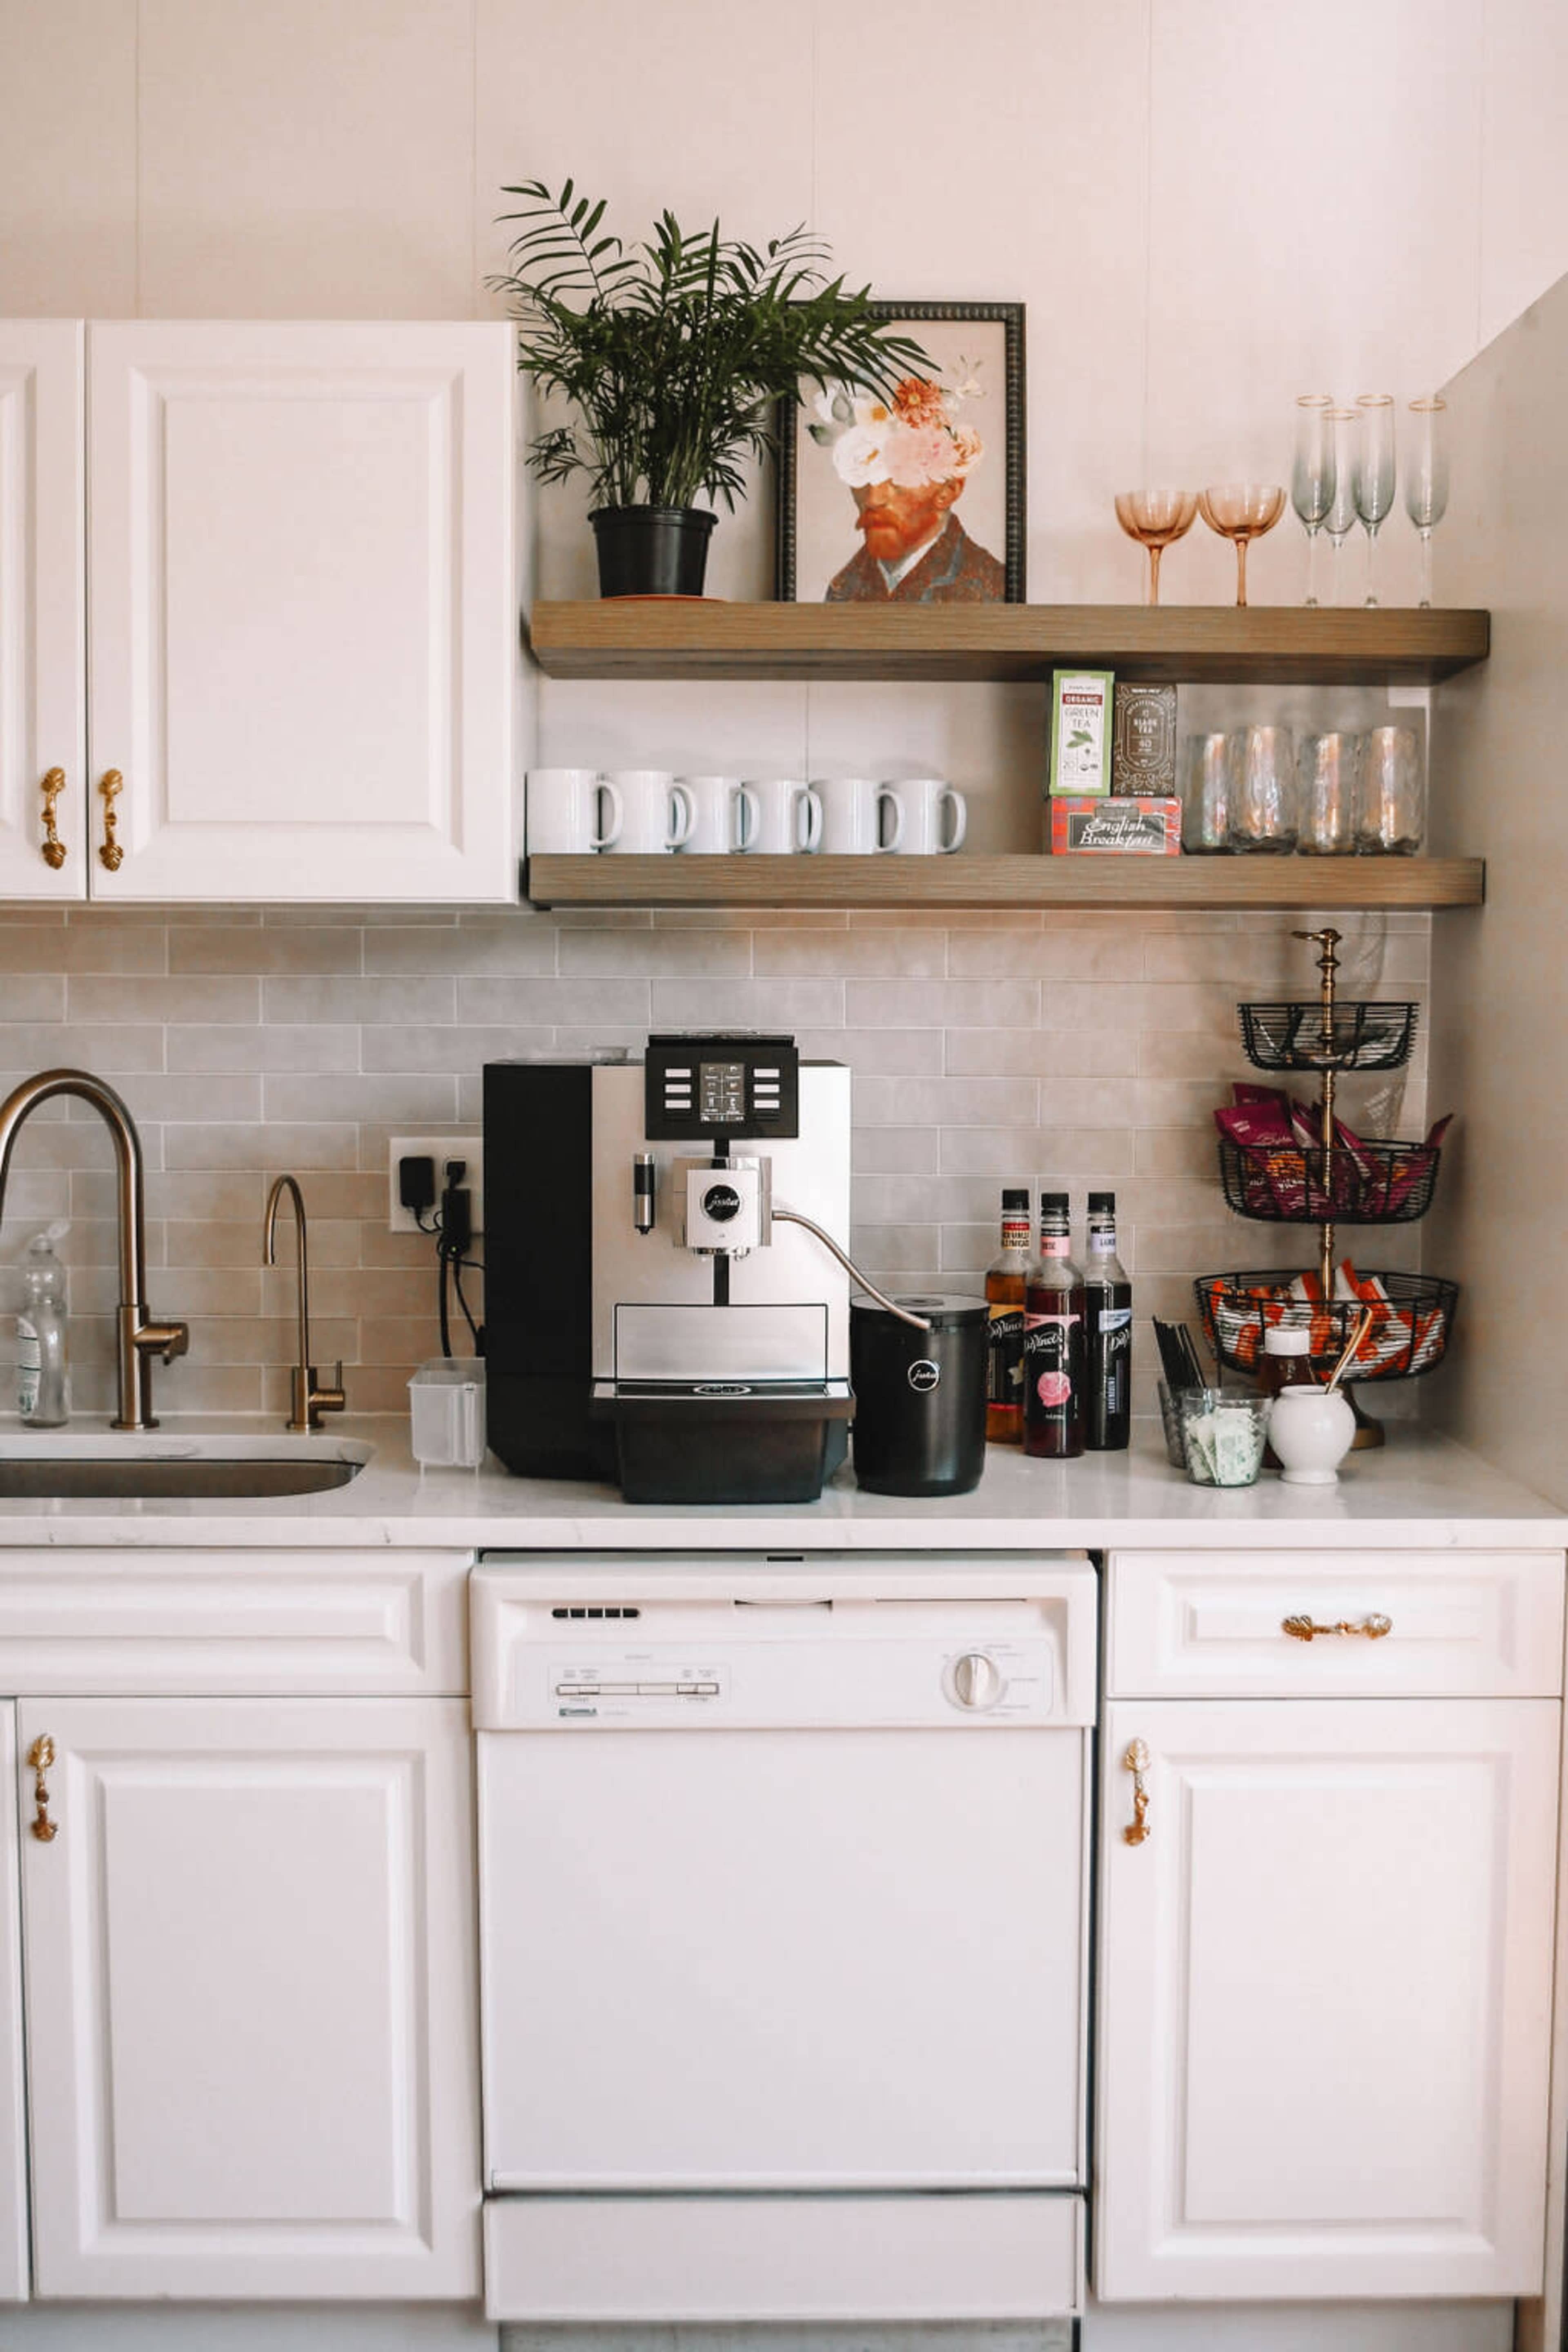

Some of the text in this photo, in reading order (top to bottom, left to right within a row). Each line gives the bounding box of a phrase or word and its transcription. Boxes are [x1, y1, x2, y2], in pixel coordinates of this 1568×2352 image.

[1065, 708, 1098, 718] GREEN
[1073, 719, 1091, 728] TEA
[1085, 815, 1145, 835] English
